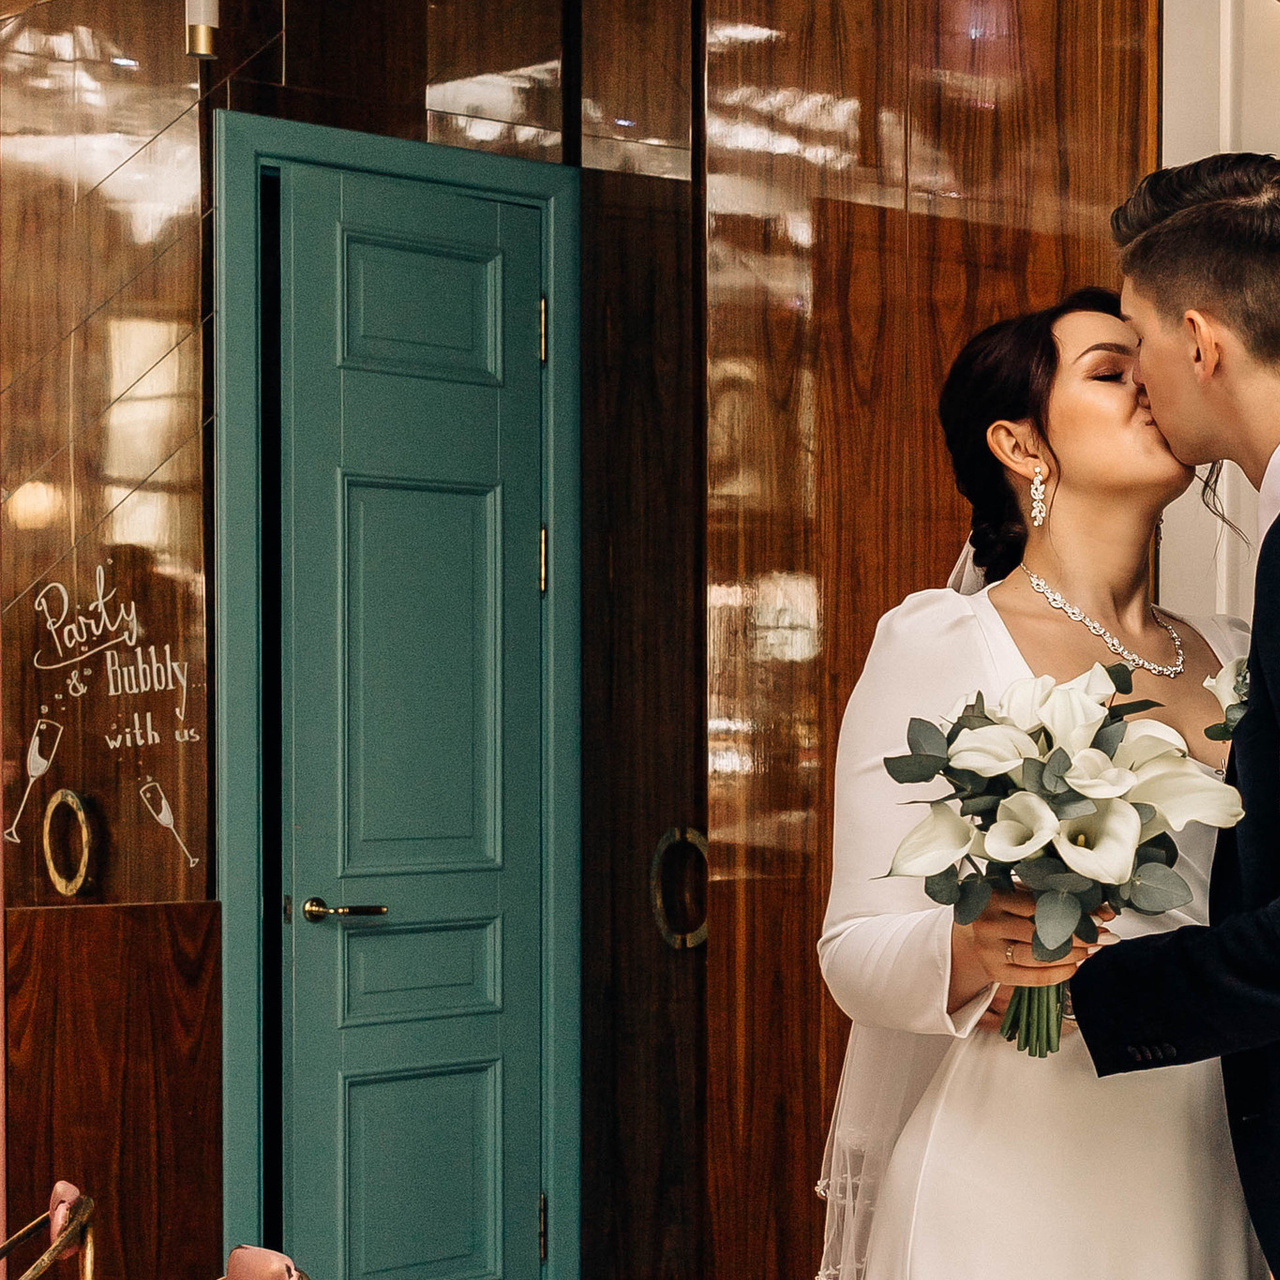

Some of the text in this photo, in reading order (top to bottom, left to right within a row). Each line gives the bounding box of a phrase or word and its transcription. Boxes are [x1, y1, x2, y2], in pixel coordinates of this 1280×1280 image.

[34, 565, 137, 669] Party
[68, 670, 88, 696] &
[105, 712, 200, 749] with us
